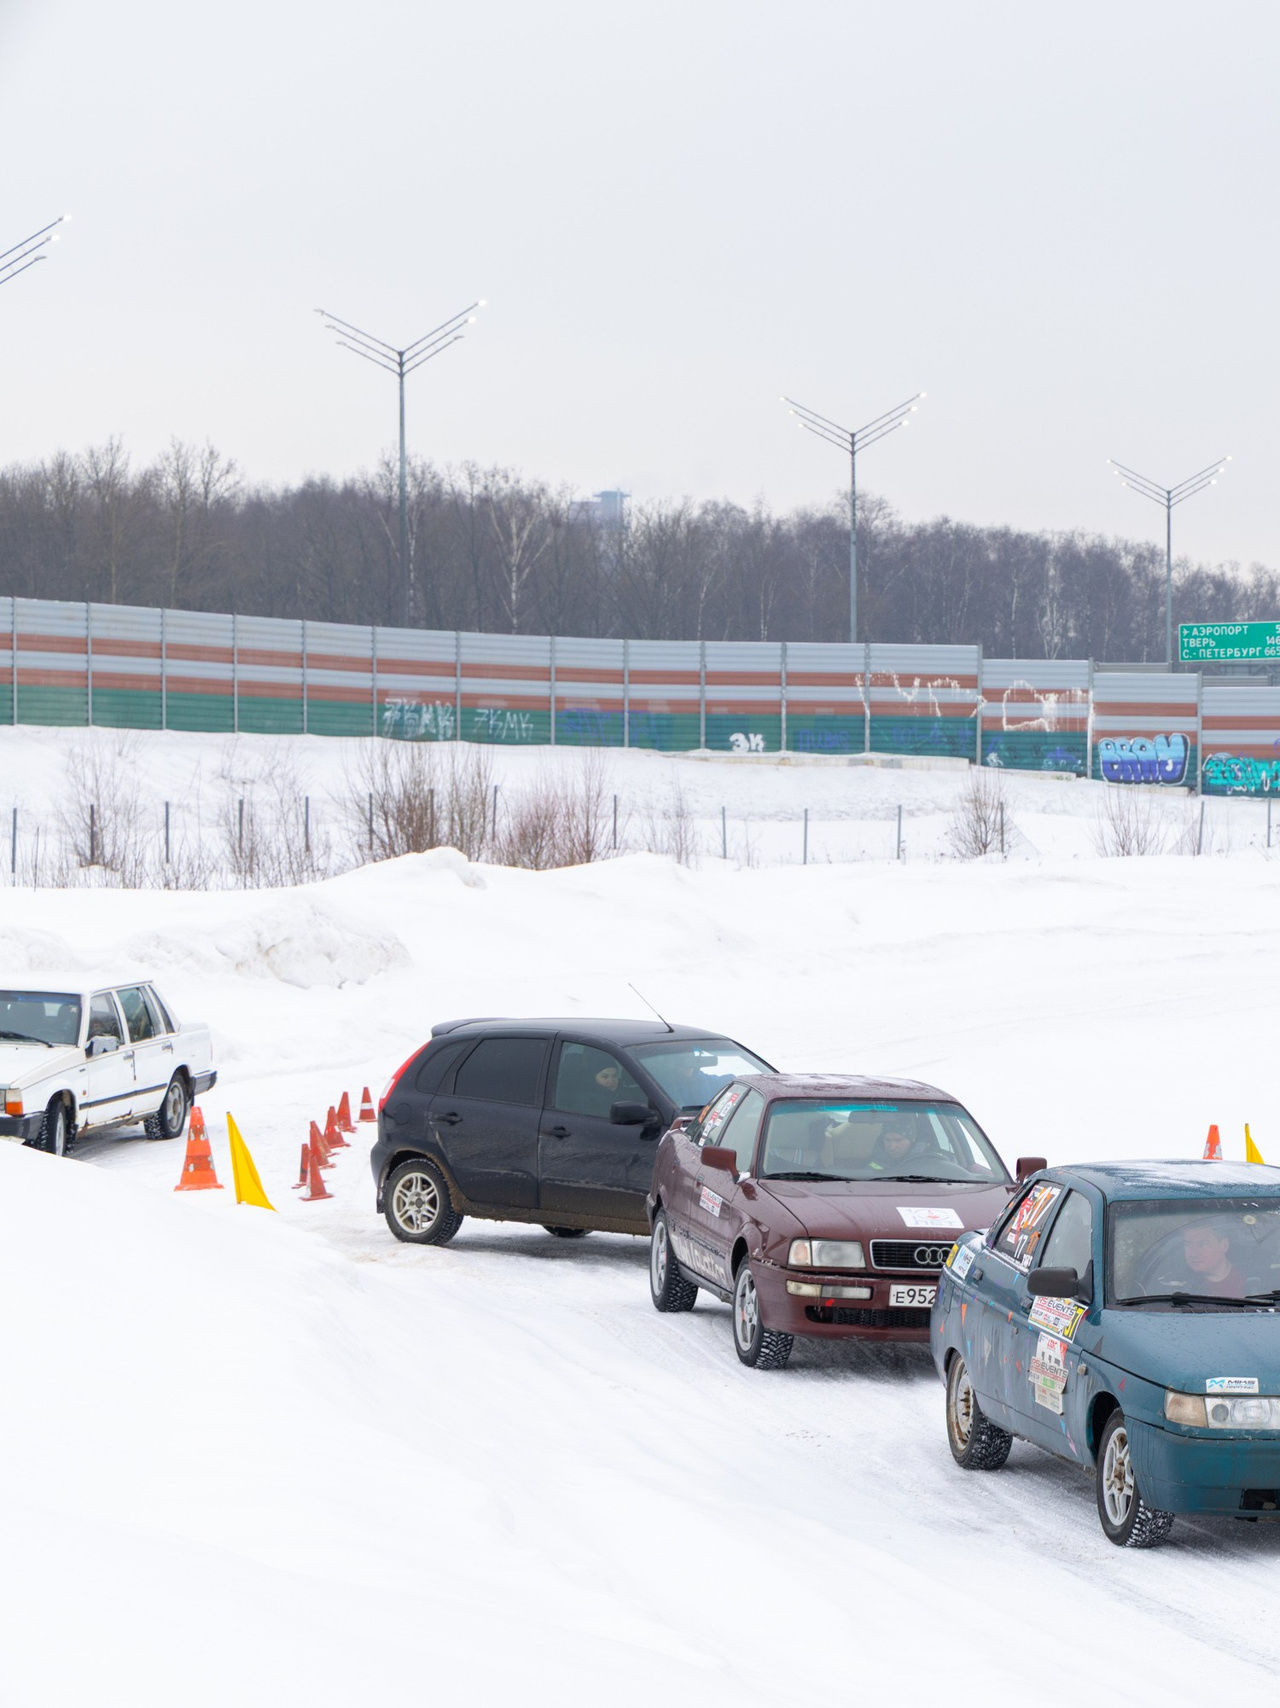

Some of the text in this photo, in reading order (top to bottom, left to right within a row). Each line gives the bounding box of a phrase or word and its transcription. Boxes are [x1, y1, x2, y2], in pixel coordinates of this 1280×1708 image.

[1192, 625, 1249, 636] АЭРОПОРТ
[1183, 638, 1216, 648] ТВЕРЬ
[1048, 1300, 1076, 1316] EVENTS
[1040, 1362, 1068, 1378] EVENTS
